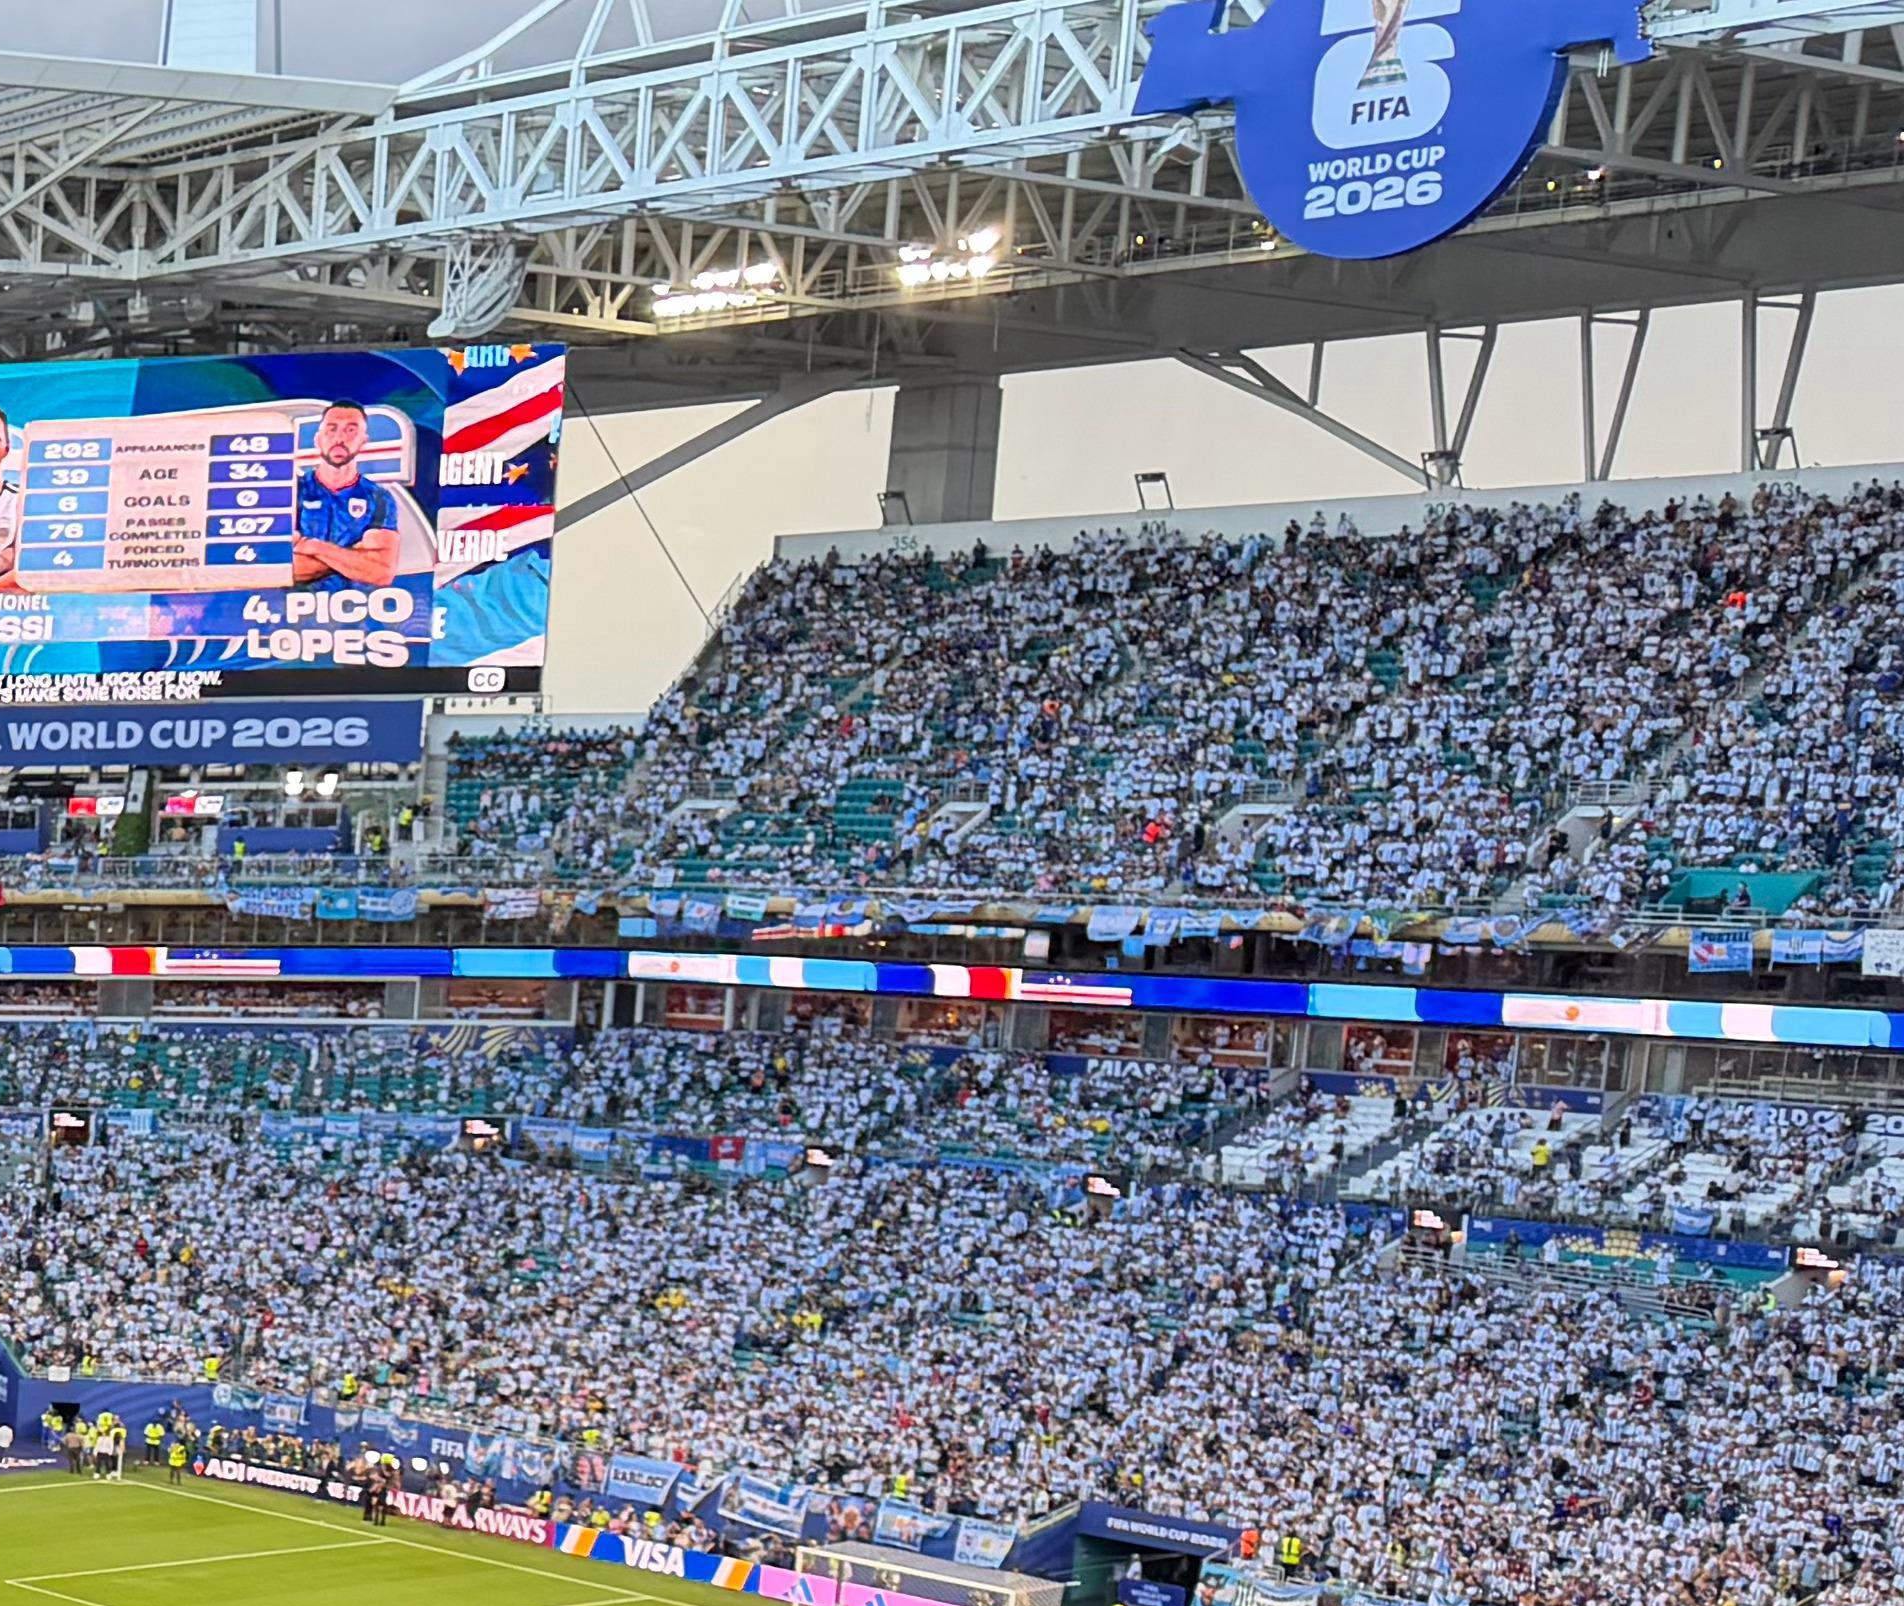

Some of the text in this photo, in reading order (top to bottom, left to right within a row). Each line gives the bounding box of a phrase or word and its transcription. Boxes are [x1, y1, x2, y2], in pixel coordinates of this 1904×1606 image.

[1351, 96, 1411, 125] FIFA
[1308, 145, 1446, 183] WORLD CUP
[1303, 171, 1443, 220] 2026
[43, 436, 270, 460] 202 APPEARANCES 48
[139, 468, 178, 480] AGE
[228, 463, 268, 479] 34
[58, 490, 259, 512] 6 GOALS 0
[47, 517, 275, 542] 76 COMPLETED 107
[126, 517, 186, 528] PASSES
[52, 545, 257, 569] 4 TURNOVERS 4
[124, 545, 185, 555] FORCED
[437, 529, 510, 562] VERDE
[242, 587, 414, 624] 4. PICO
[247, 629, 409, 668] LOPES
[8, 674, 52, 690] LONG
[55, 674, 99, 688] UNTIL
[102, 673, 142, 686] KICK
[143, 672, 177, 686] OFF
[179, 671, 224, 685] NOW.
[473, 672, 499, 687] CC
[15, 687, 60, 702] MAKE
[62, 686, 109, 701] SOME
[112, 686, 161, 701] NOISE
[165, 685, 200, 700] FOR
[7, 721, 143, 751] WORLD
[149, 719, 227, 750] CUP
[232, 717, 370, 748] 2026
[431, 1437, 465, 1460] FIFA
[204, 1457, 245, 1483] ADI
[1106, 1517, 1129, 1532] FIFA
[1131, 1522, 1168, 1541] WORLD
[1169, 1528, 1189, 1543] CUP
[621, 1535, 685, 1578] VISA
